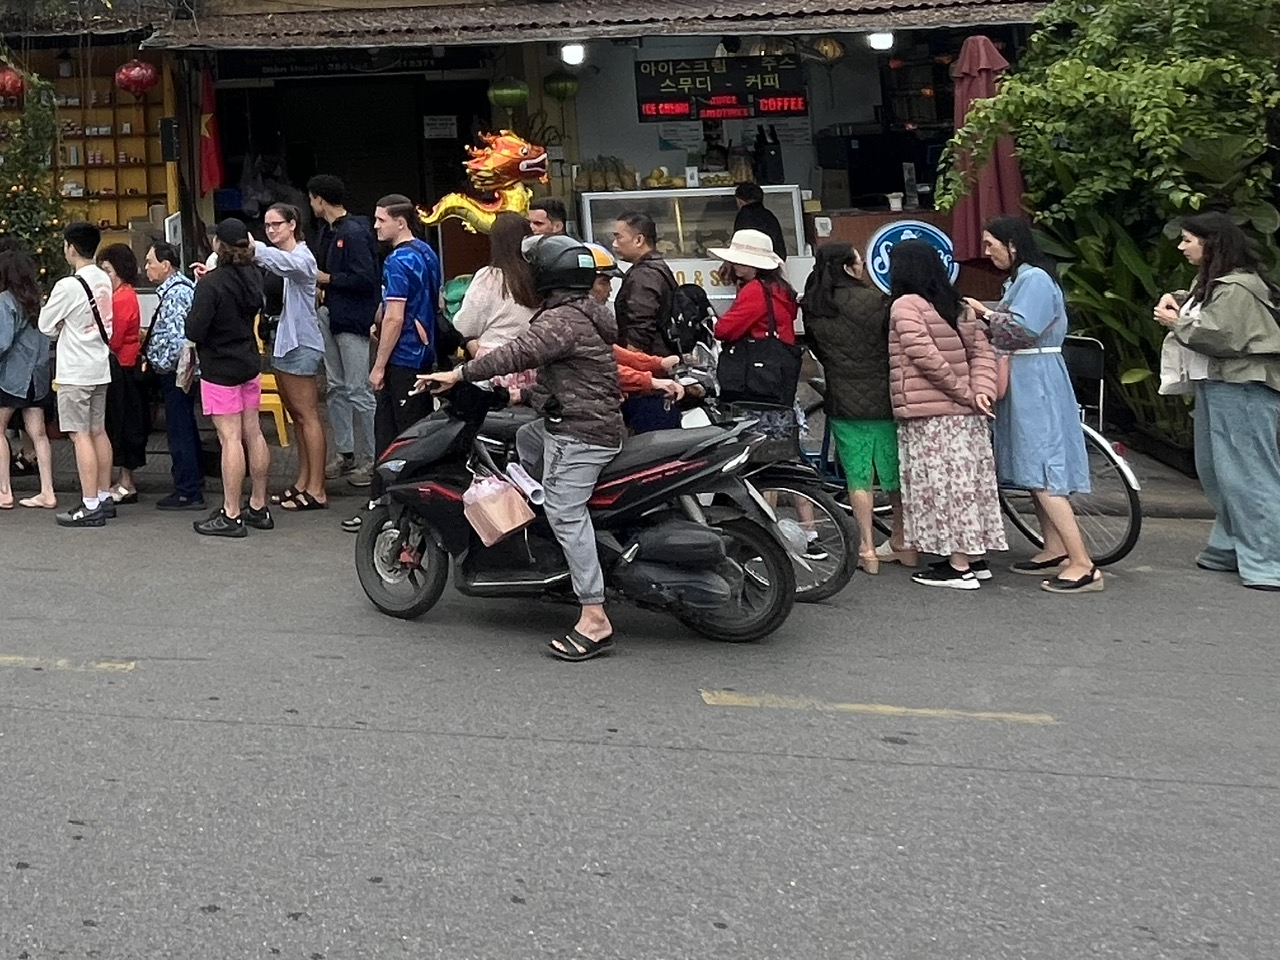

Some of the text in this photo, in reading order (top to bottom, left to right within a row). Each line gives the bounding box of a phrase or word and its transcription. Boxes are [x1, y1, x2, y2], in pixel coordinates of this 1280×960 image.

[640, 58, 728, 76] 아이스크림
[761, 56, 797, 71] 주스
[660, 75, 712, 94] 스무디
[745, 73, 780, 90] 커피
[642, 103, 657, 115] ICE
[759, 97, 805, 111] COFFEE
[694, 270, 704, 286] &
